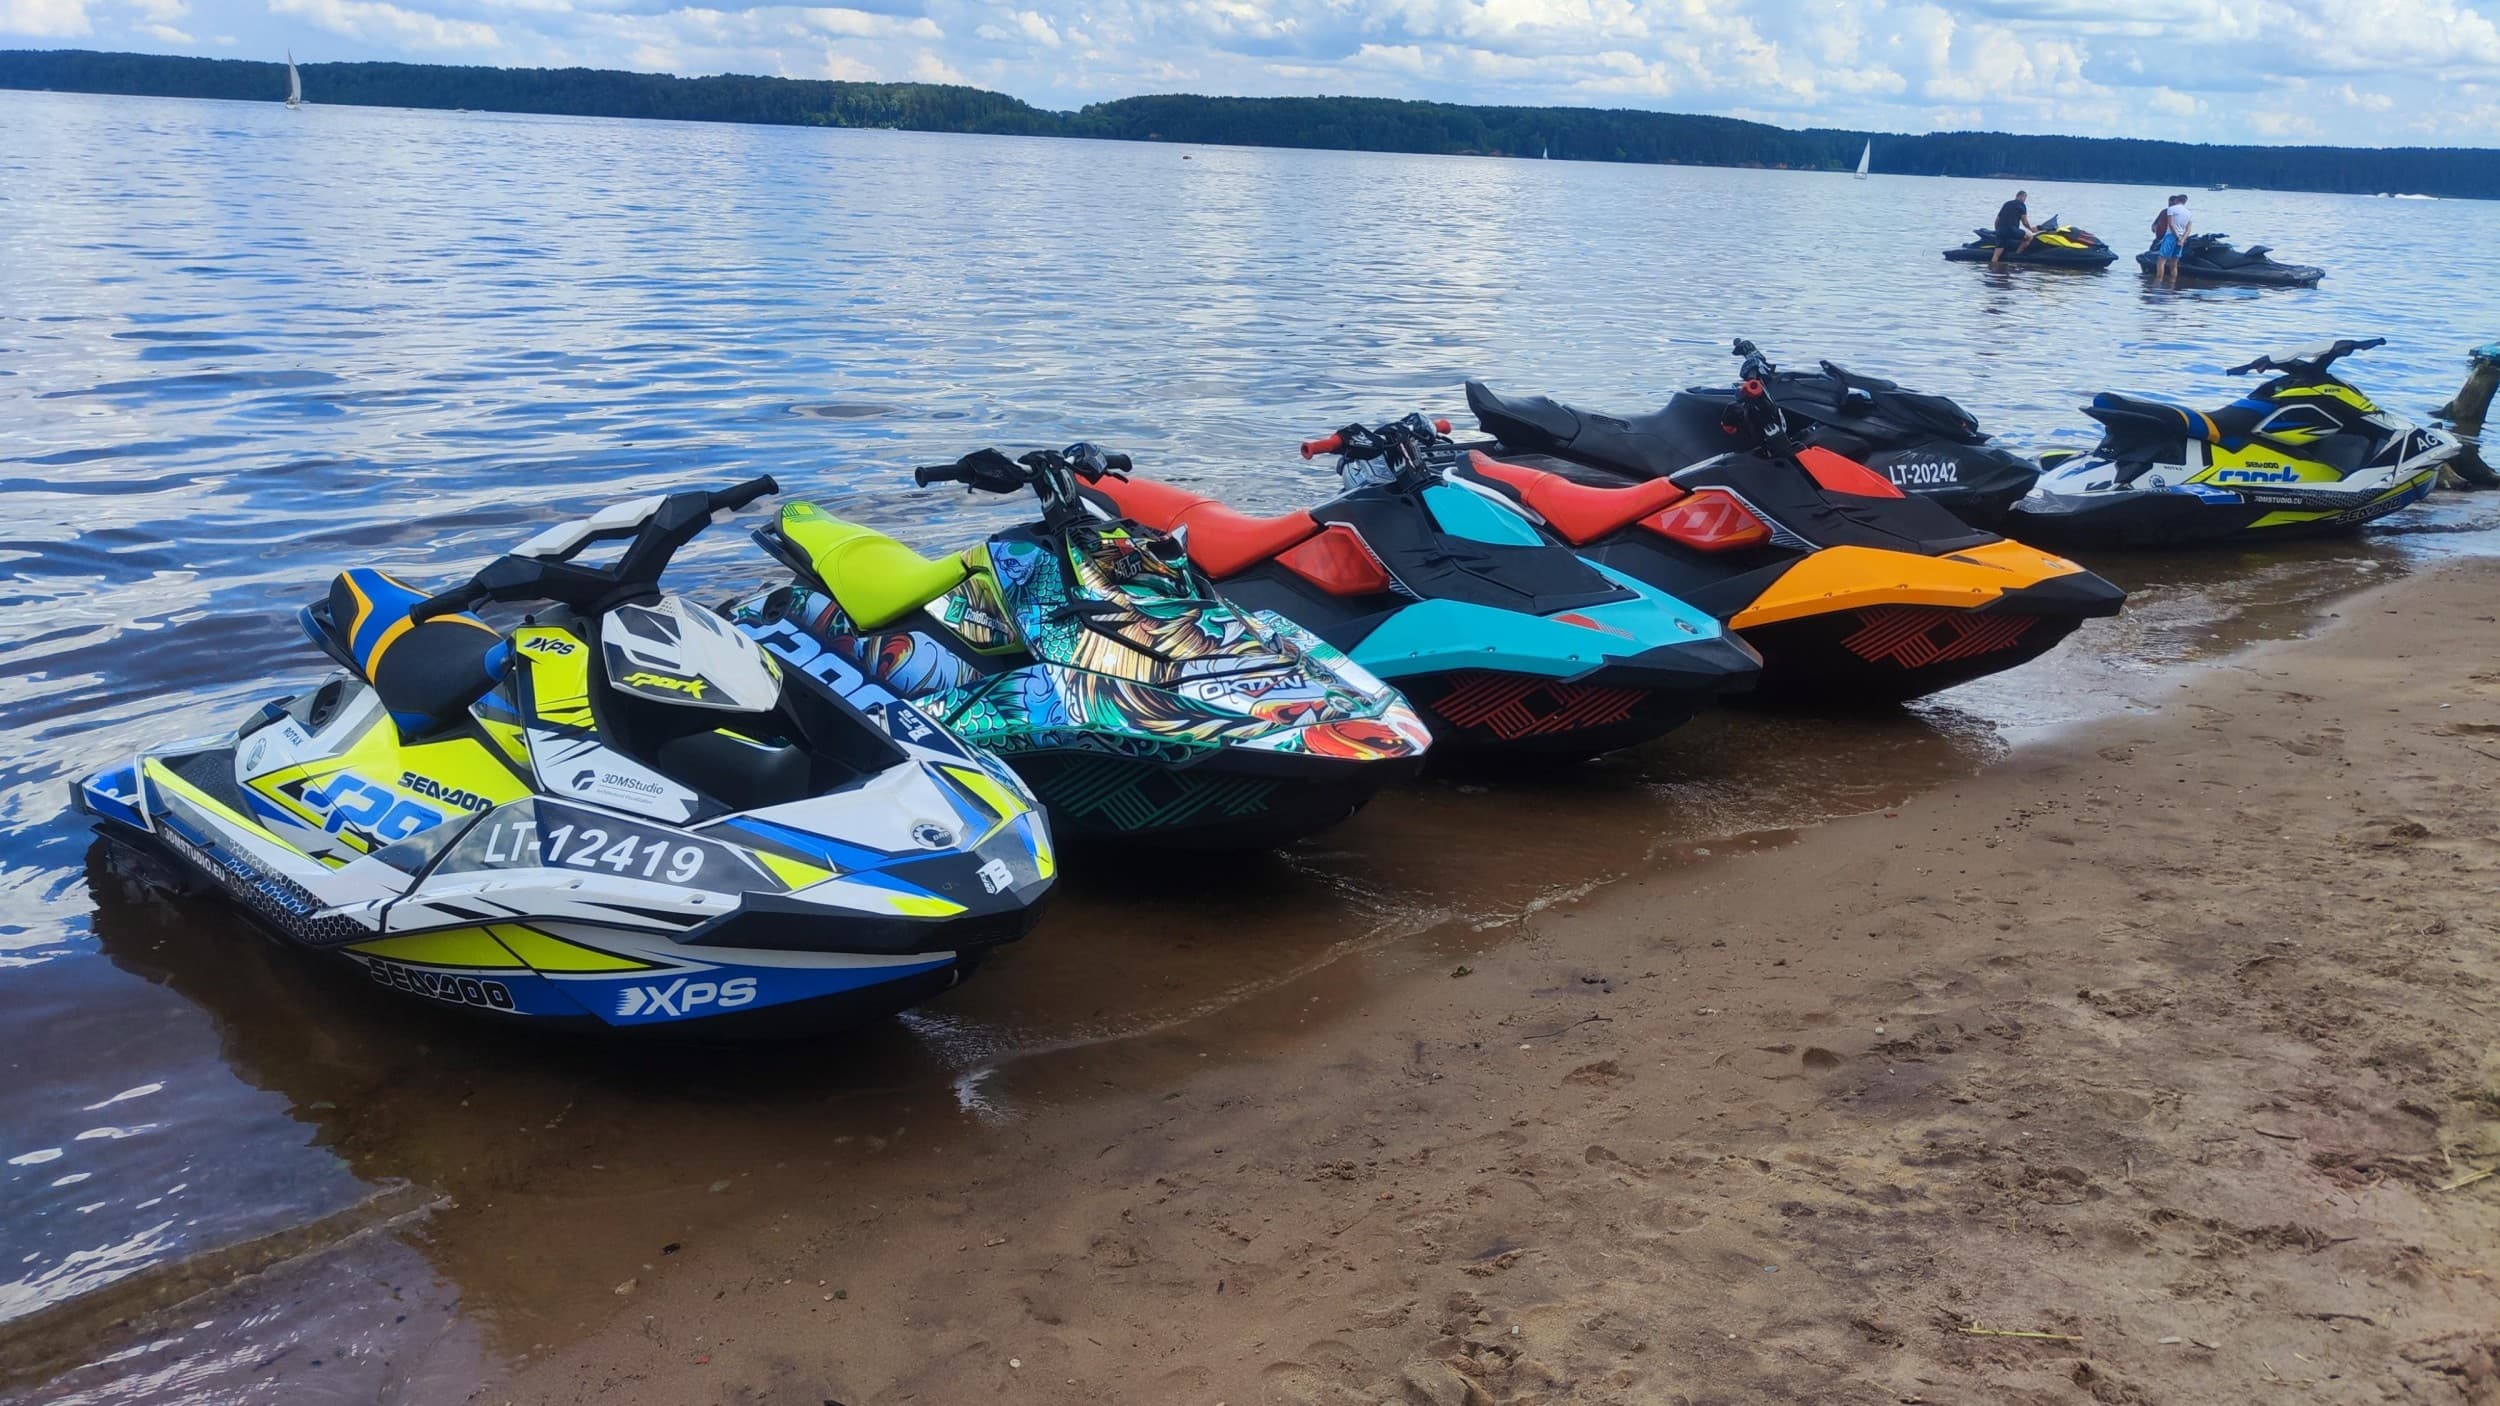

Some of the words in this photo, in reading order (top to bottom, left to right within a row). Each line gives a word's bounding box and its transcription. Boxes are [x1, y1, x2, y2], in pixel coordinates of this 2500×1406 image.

[1888, 462, 1958, 485] LT-20242
[529, 637, 575, 655] XPS
[601, 773, 664, 795] 3DMStudio
[164, 827, 226, 882] 3DMSTUDIO.EU
[484, 821, 705, 883] LT-12419
[641, 978, 757, 1017] XPS
